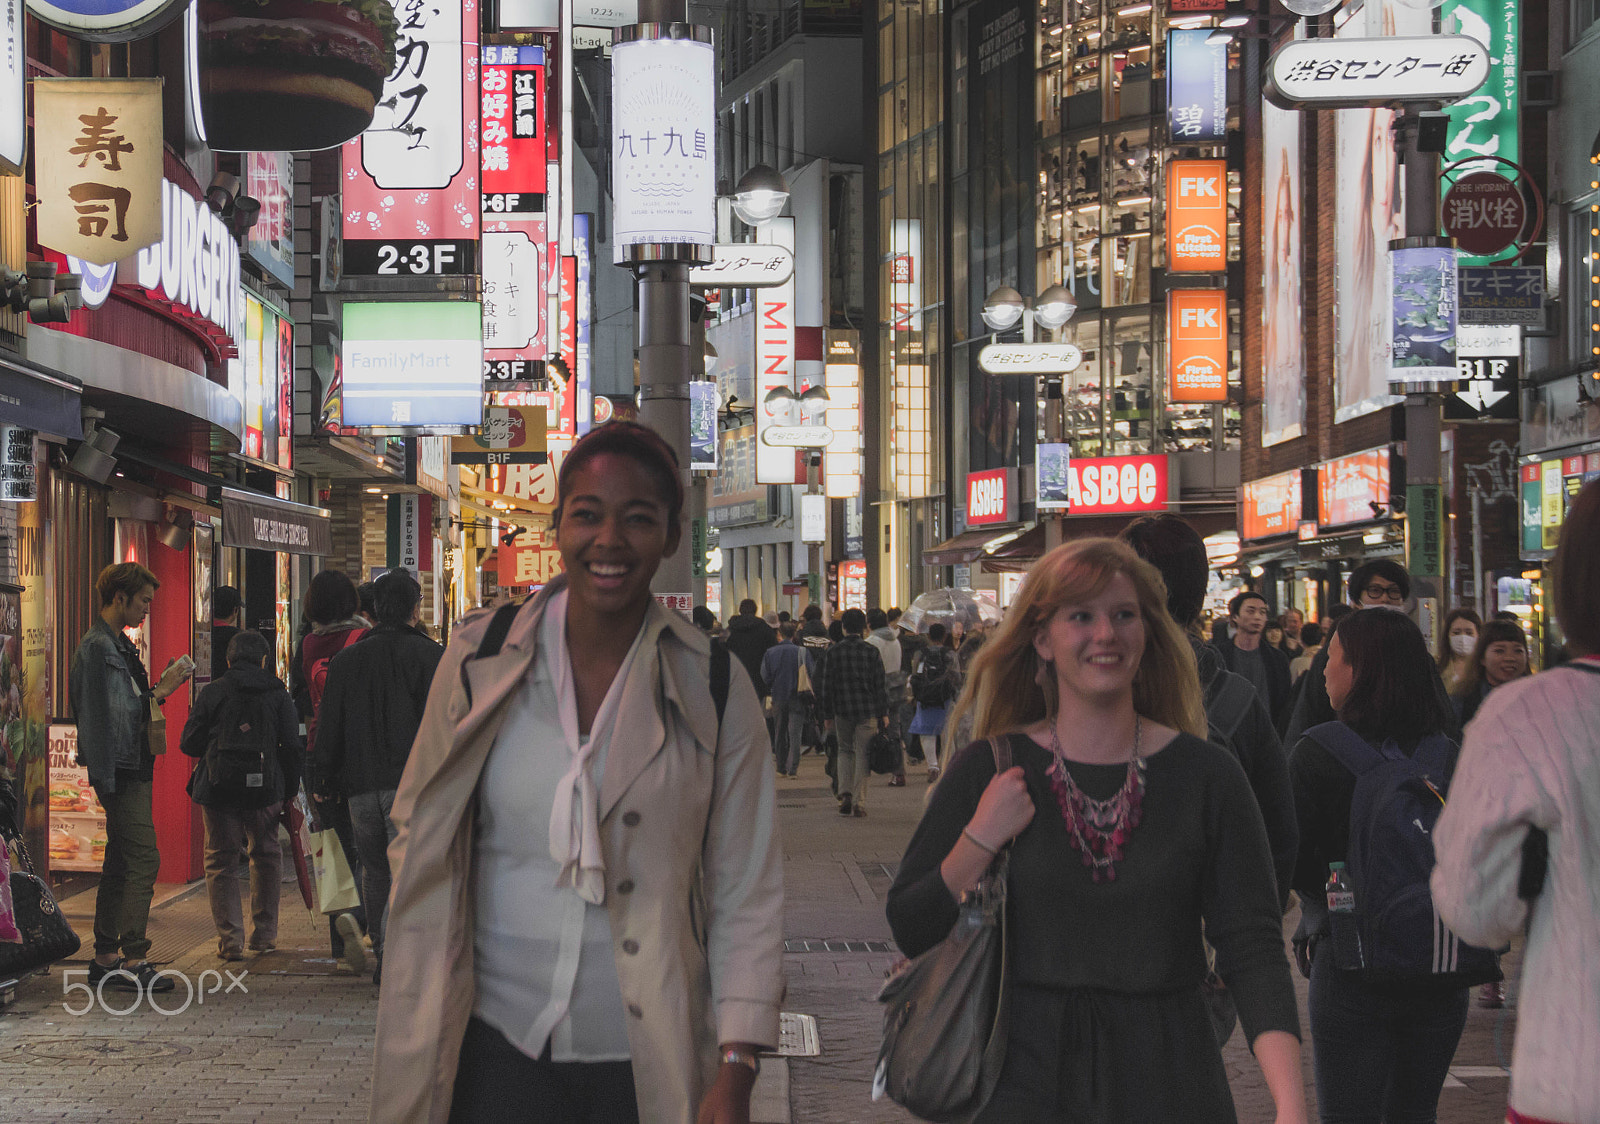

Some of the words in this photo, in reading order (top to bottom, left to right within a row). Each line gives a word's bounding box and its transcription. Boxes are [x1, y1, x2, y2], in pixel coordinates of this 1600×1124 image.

[1176, 33, 1193, 47] 2F
[482, 46, 519, 65] 5席
[1284, 53, 1478, 82] 渋谷センター街
[1503, 1, 1516, 110] ステーキと焙煎カレー
[515, 73, 535, 136] 江戸前
[482, 67, 509, 171] お好み焼
[1175, 103, 1205, 136] 碧
[618, 126, 707, 160] 九十九島
[68, 106, 134, 242] 寿司
[1180, 177, 1218, 197] FK
[1455, 183, 1472, 193] FIRE
[1474, 183, 1510, 193] HYDRANT
[1449, 197, 1519, 229] 消火栓
[1176, 243, 1221, 252] Kitchen
[1185, 234, 1213, 244] First
[504, 241, 519, 317] ケーキと
[1437, 257, 1450, 318] 九十九島
[483, 280, 499, 340] お食事
[1180, 308, 1218, 327] FK
[351, 352, 452, 372] FamilyMart
[1185, 365, 1213, 375] First
[1458, 359, 1510, 381] B1F
[1176, 374, 1222, 383] Kitchen
[391, 401, 412, 422] 酒
[487, 453, 511, 464] B1F
[970, 477, 1004, 516] ASBee
[1068, 463, 1157, 506] ASBee
